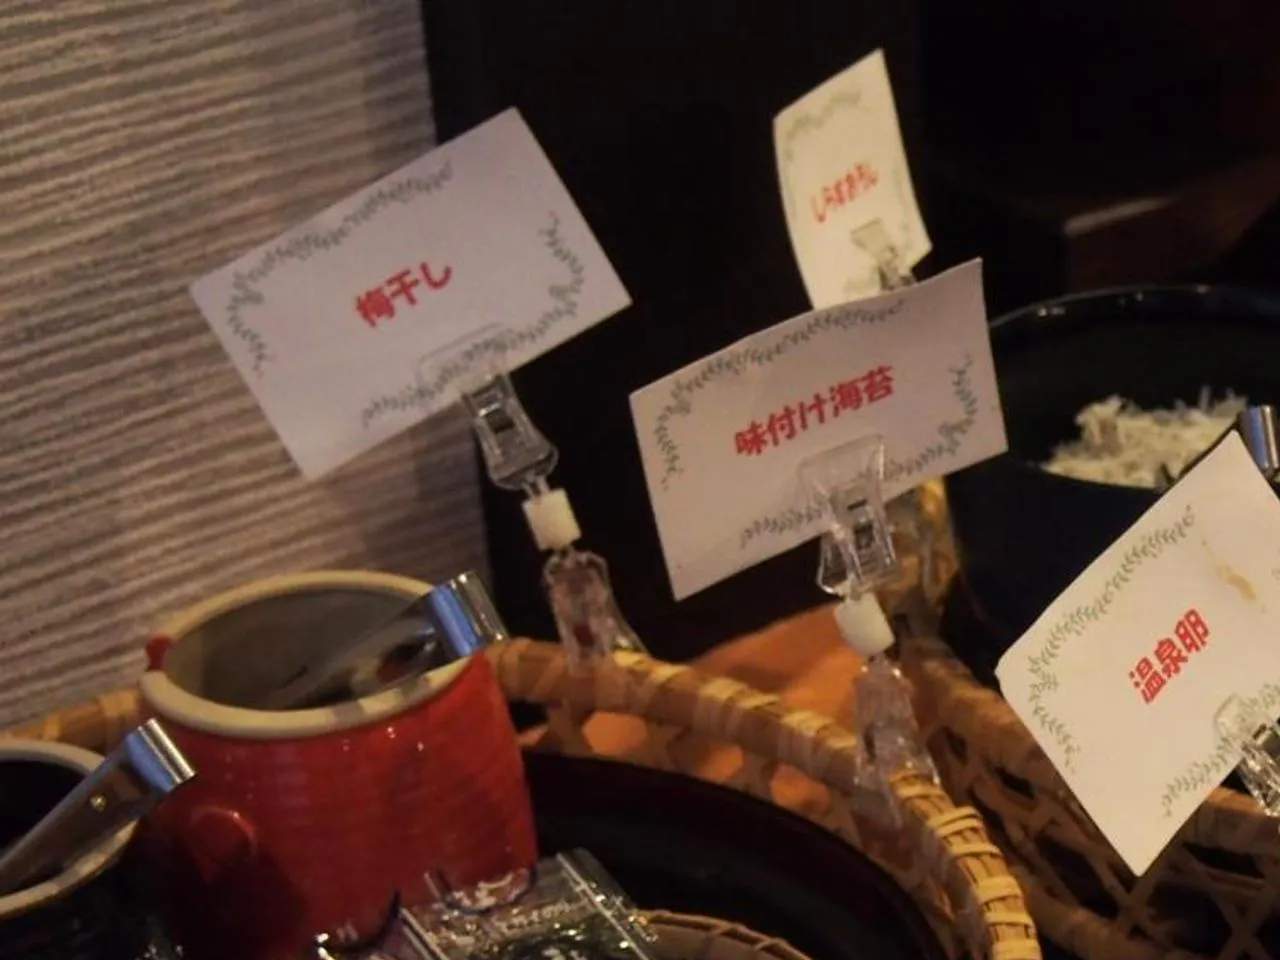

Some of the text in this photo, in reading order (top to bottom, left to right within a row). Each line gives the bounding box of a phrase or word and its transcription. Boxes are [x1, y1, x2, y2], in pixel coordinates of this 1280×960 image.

[355, 262, 453, 328] 梅干し
[735, 366, 894, 455] 味付け海苔
